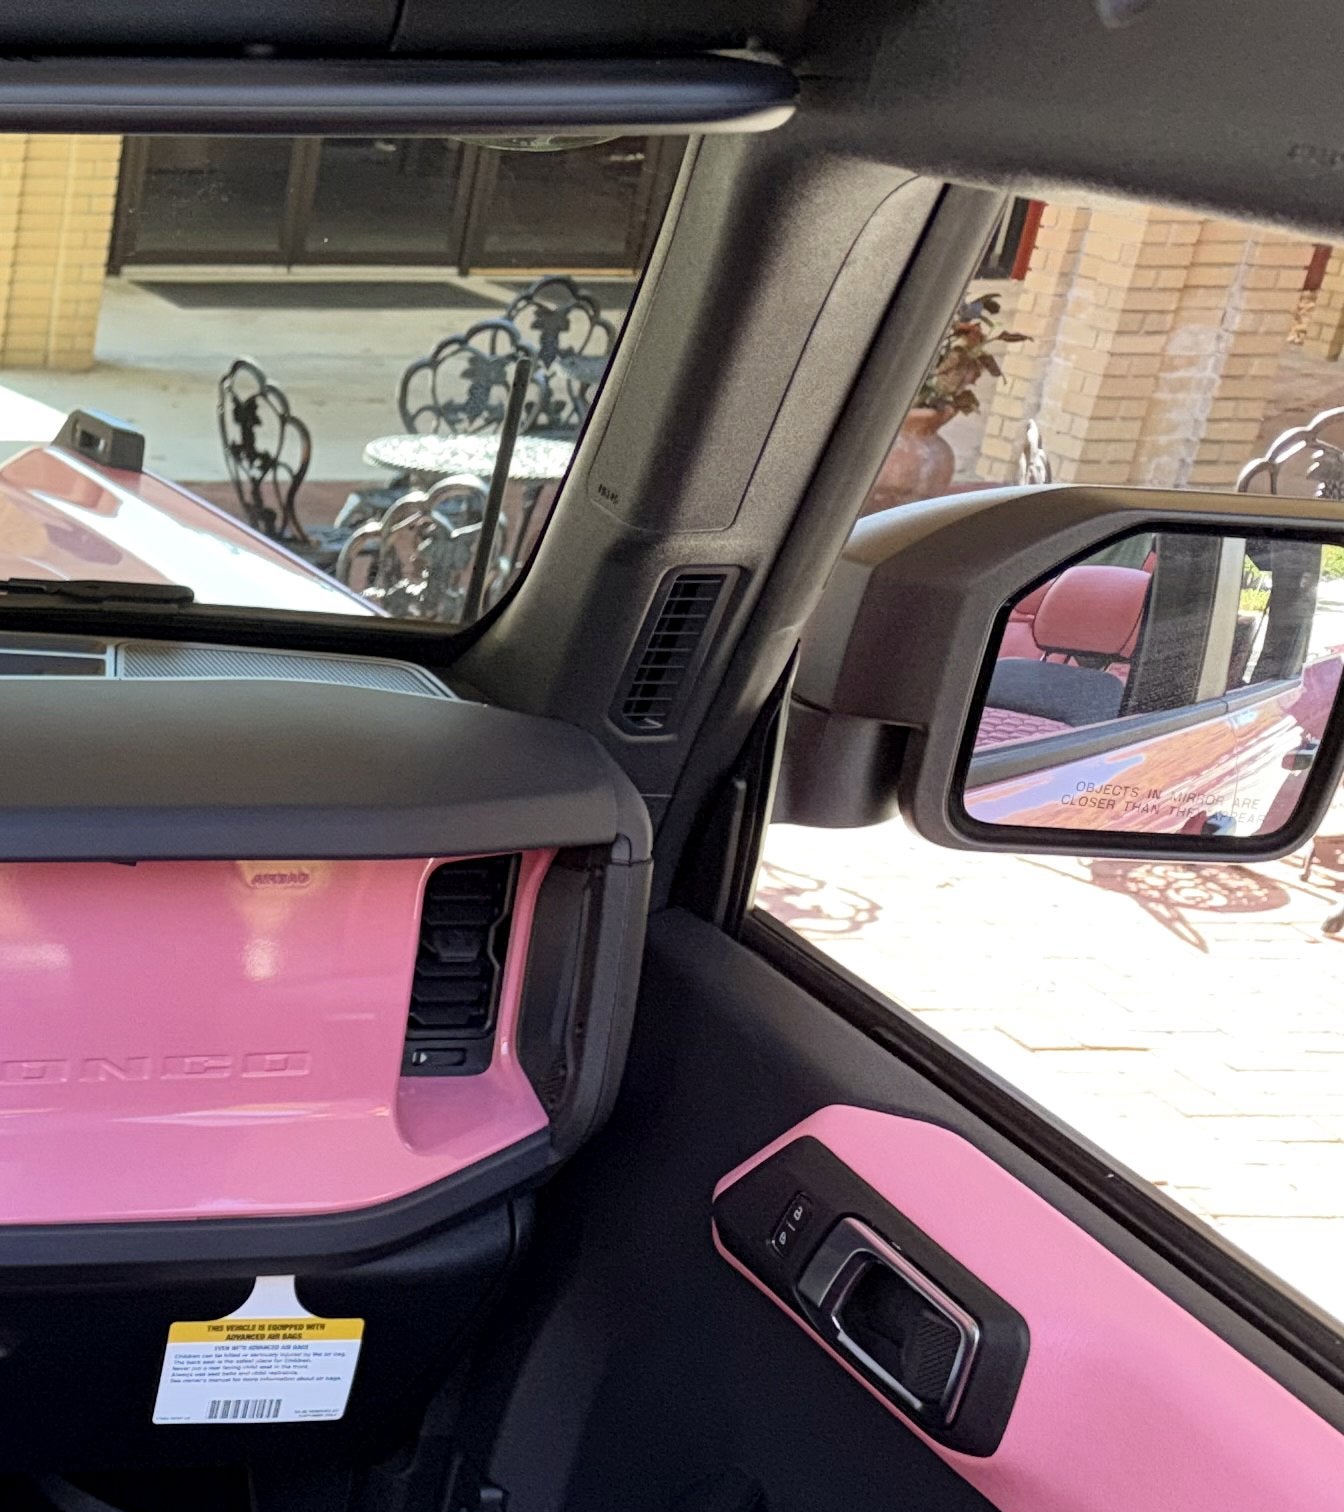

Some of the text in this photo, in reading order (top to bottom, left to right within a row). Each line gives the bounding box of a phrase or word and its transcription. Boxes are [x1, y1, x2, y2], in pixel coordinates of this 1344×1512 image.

[1060, 794, 1116, 810] CLOSER
[1124, 802, 1160, 815] THAN
[1076, 781, 1260, 810] OBJECTS IN MIRROR ARE
[226, 1324, 256, 1332] VEHICLE
[257, 1324, 265, 1332] IS
[267, 1323, 304, 1332] EQUIPPED
[306, 1323, 326, 1331] WITH
